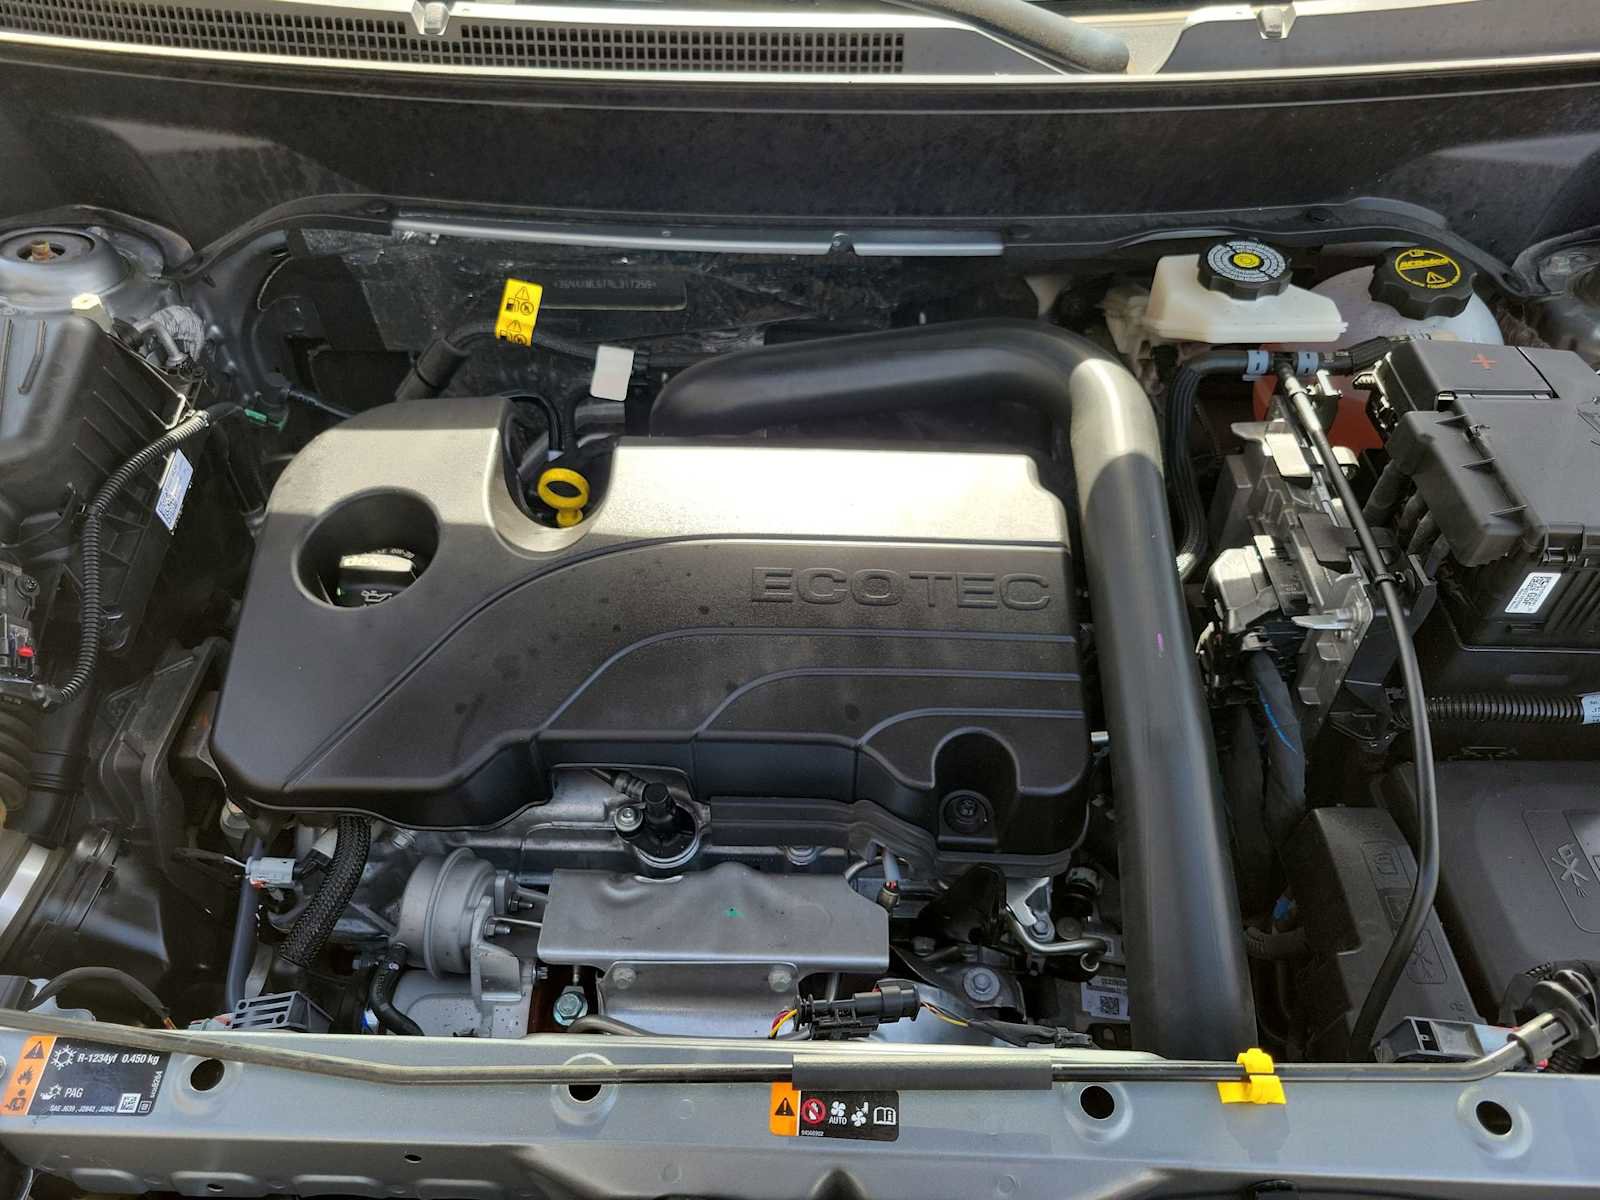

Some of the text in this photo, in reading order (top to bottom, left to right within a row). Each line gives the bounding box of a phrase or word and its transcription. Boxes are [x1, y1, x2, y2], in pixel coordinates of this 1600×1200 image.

[751, 567, 1050, 611] ECOTEC
[77, 1053, 160, 1066] R-1234yf 0.450 kg
[64, 1088, 84, 1098] PAG
[829, 1116, 848, 1125] AUTO
